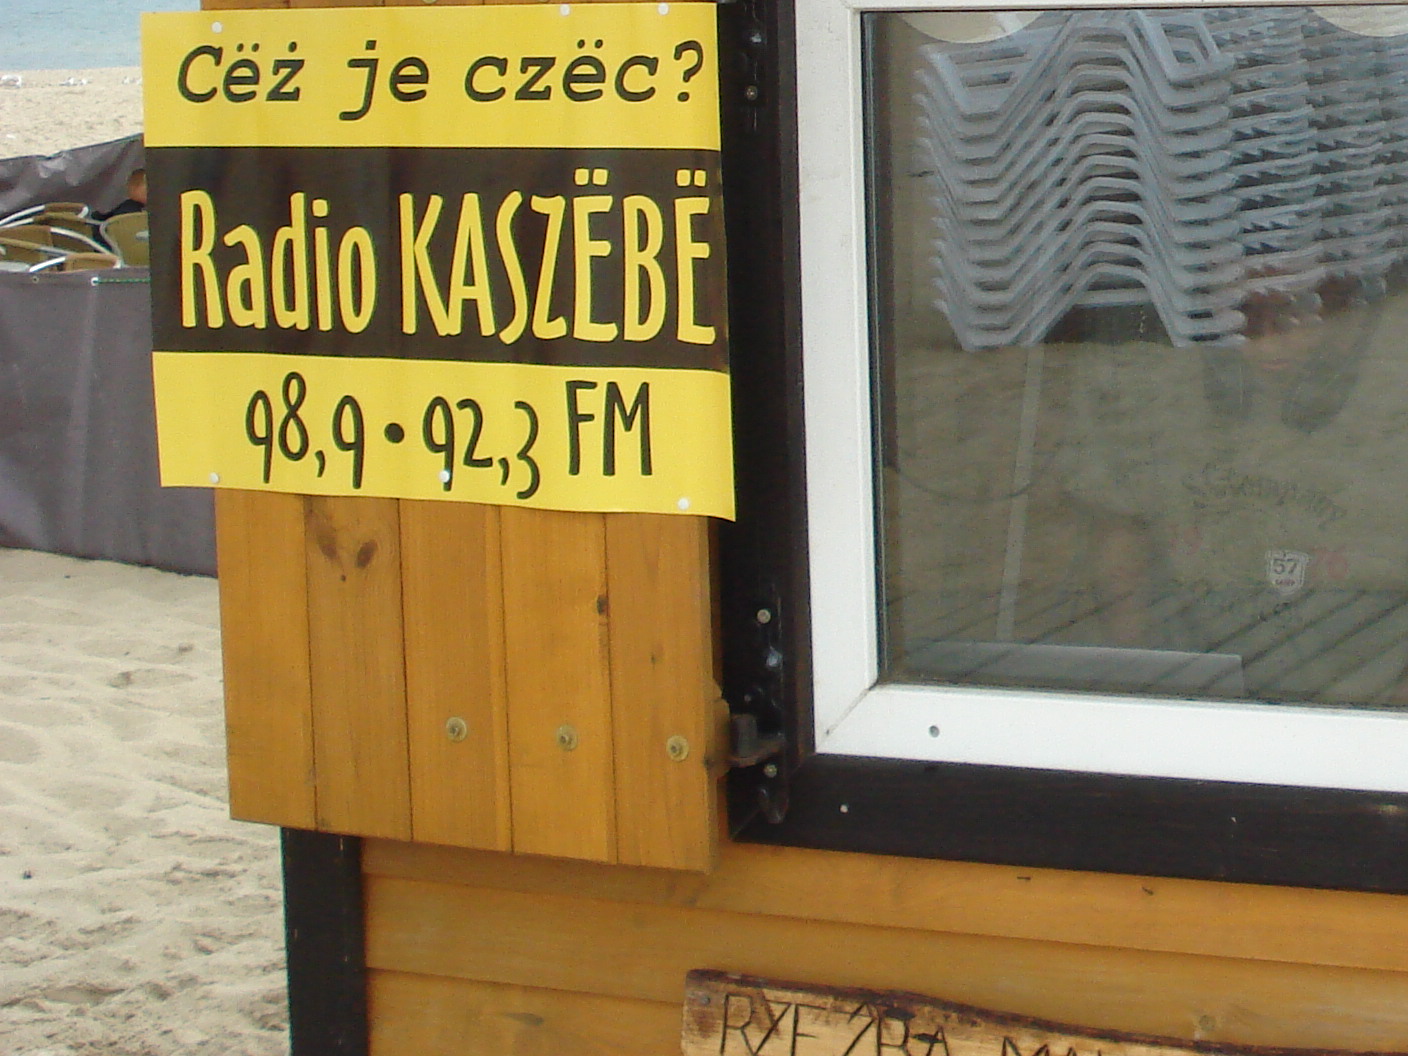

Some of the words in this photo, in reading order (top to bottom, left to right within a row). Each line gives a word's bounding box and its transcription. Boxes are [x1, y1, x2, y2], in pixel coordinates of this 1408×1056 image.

[177, 41, 305, 103] Cëż
[338, 39, 430, 121] je
[464, 38, 705, 103] czëc?
[179, 190, 378, 334] Radio
[399, 168, 717, 346] KASZËBË
[245, 371, 366, 489] 98,9
[422, 395, 540, 500] 92,3
[565, 380, 653, 476] FM
[1273, 557, 1299, 575] 57
